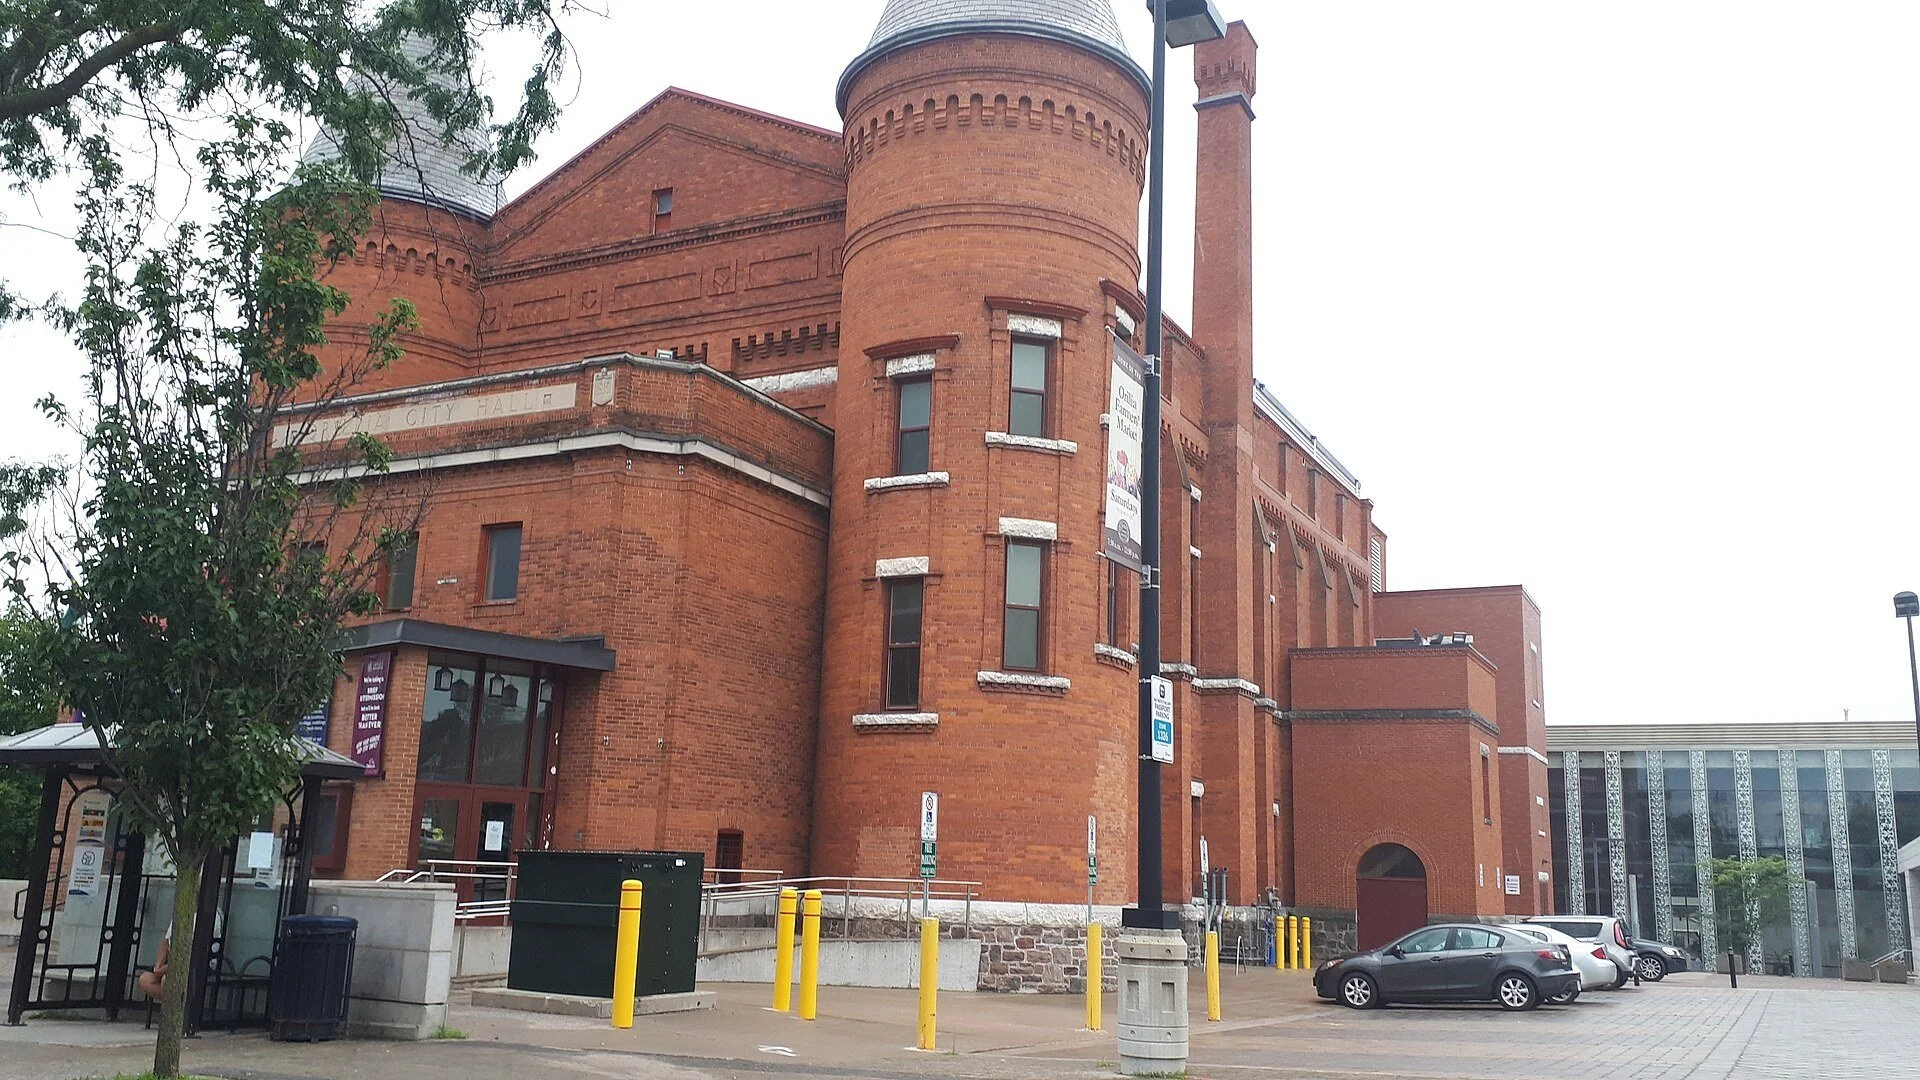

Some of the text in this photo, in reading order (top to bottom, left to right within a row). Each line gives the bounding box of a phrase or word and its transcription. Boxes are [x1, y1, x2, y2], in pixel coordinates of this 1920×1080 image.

[406, 402, 455, 426] CITY
[476, 392, 533, 417] HALL
[1118, 385, 1137, 409] Orillia
[1116, 415, 1138, 443] Market
[1110, 488, 1138, 517] Saturdays
